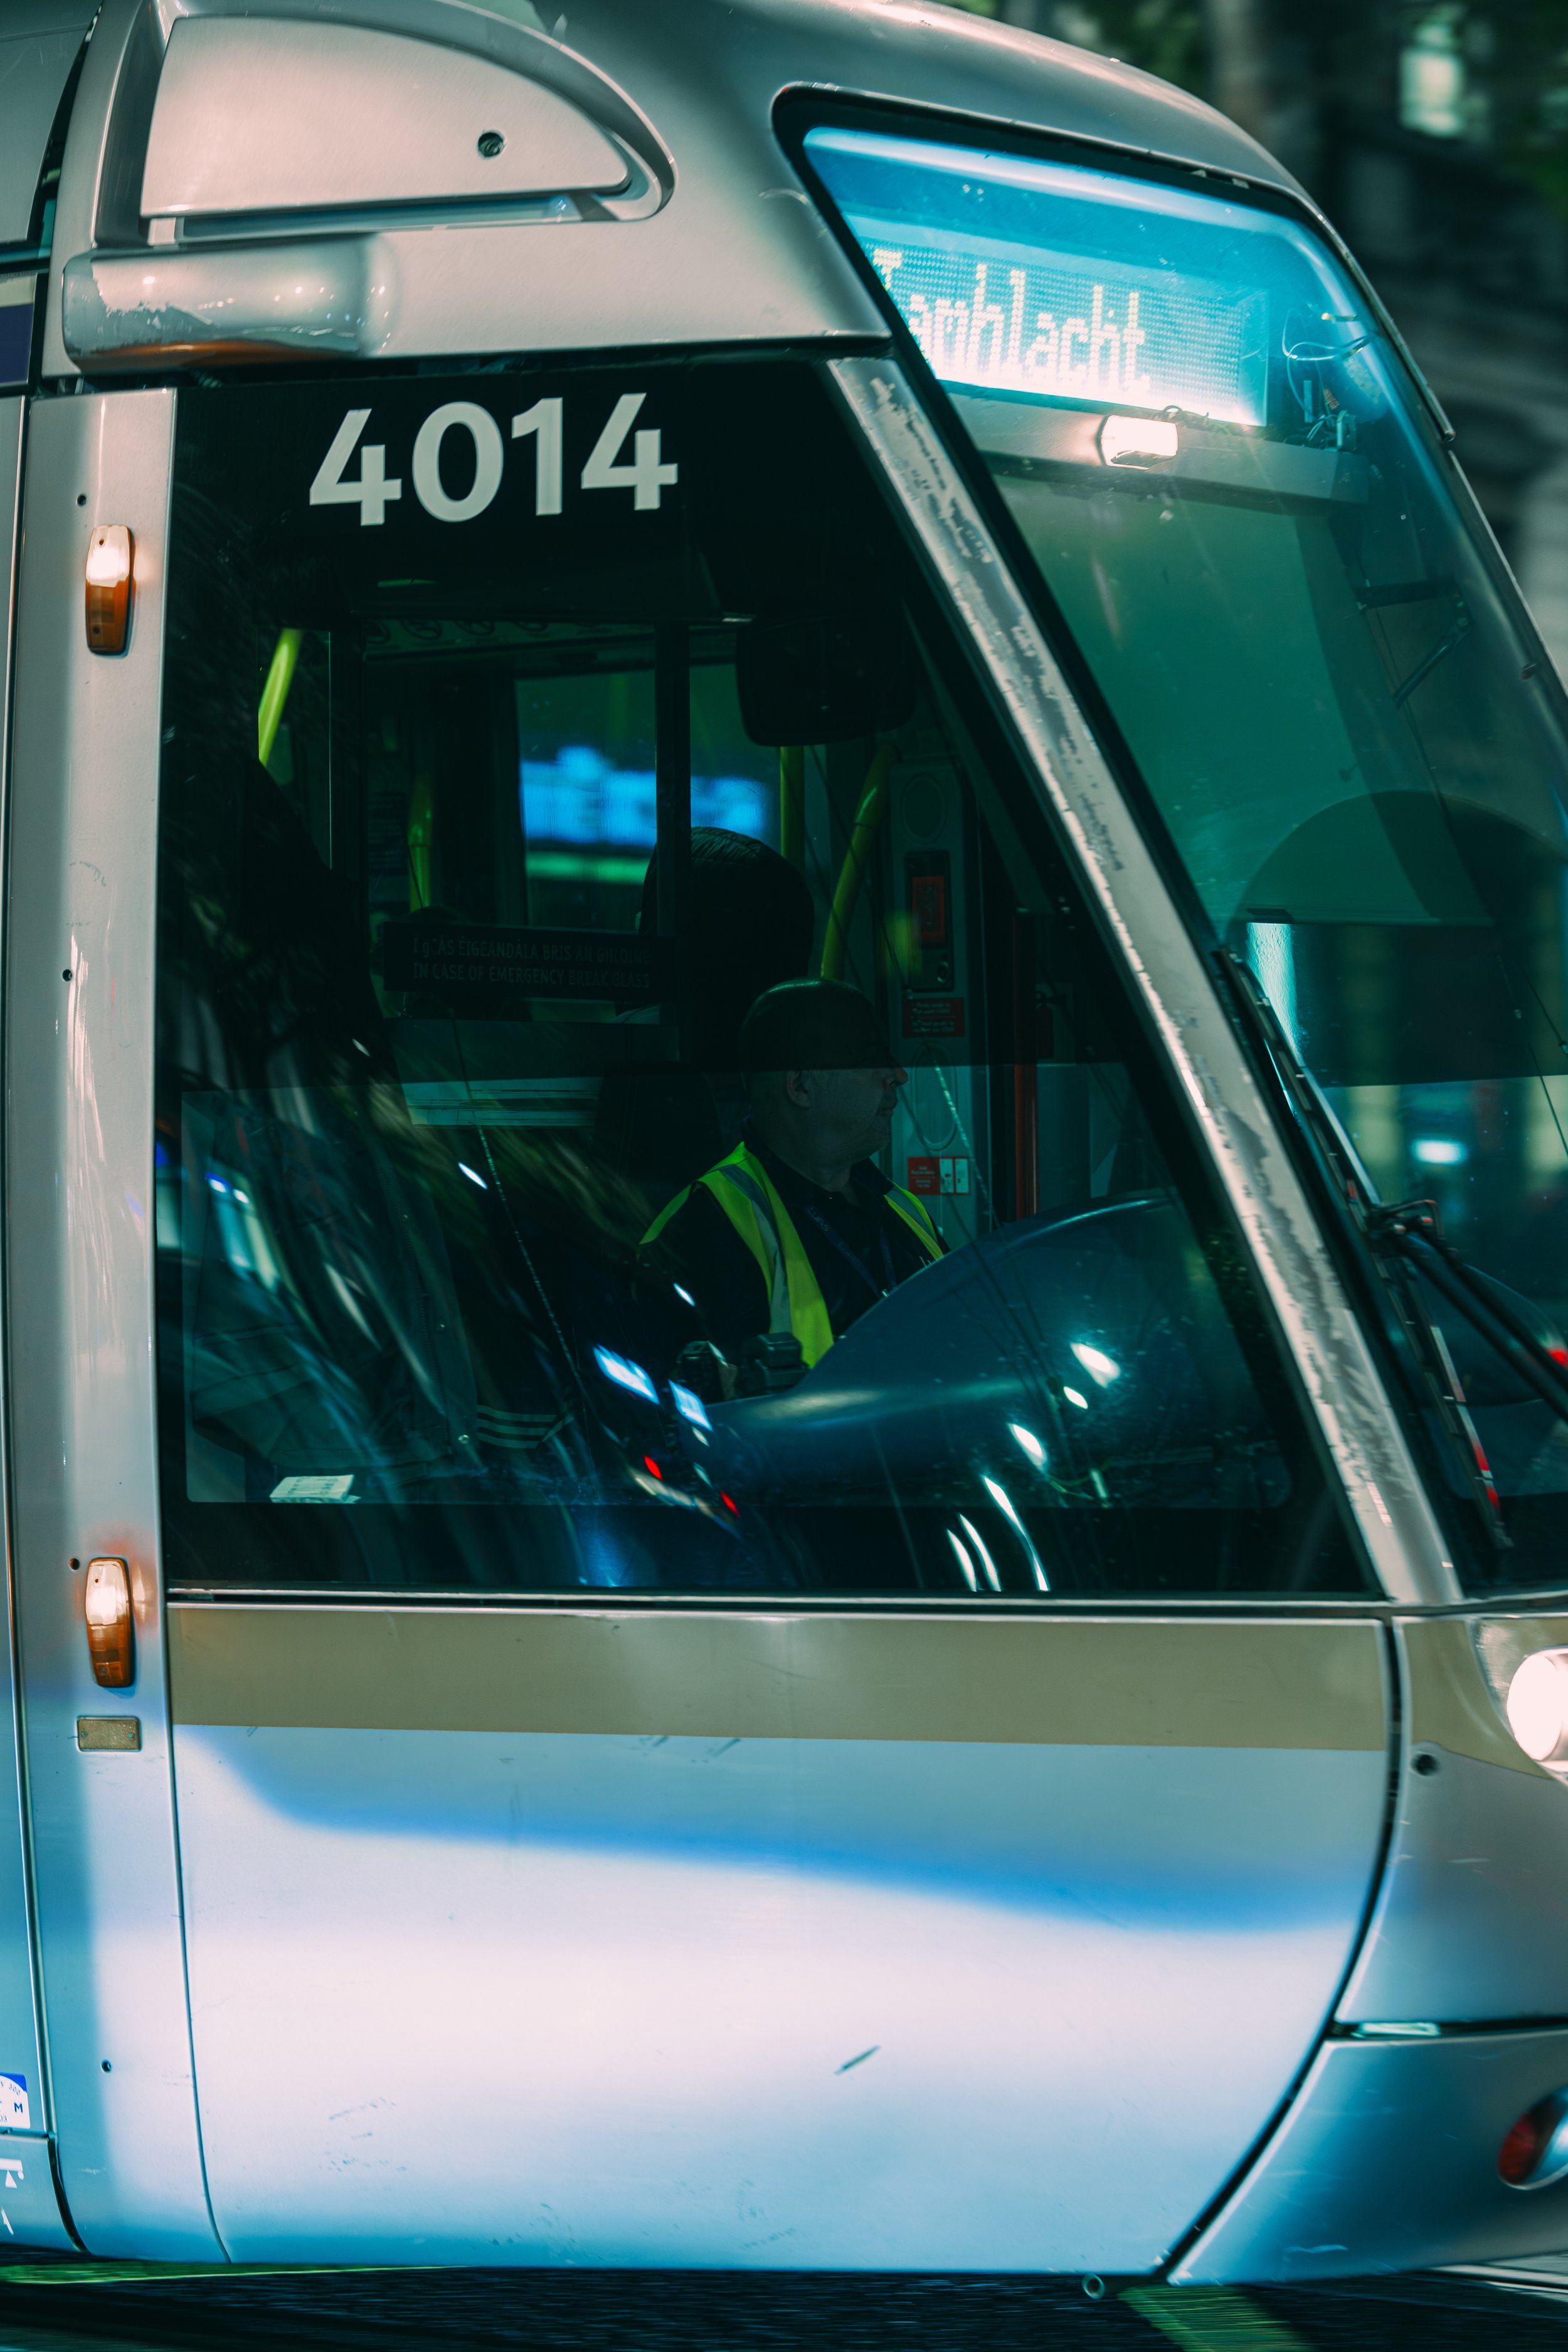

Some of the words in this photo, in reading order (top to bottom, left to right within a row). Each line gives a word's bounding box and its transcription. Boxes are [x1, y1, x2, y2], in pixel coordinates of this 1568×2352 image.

[309, 393, 678, 526] 4014
[458, 936, 539, 960] ÉIGEANDÁLA
[543, 944, 572, 961] BRIS
[575, 945, 592, 962] AN
[596, 947, 650, 964] GHLOINE
[413, 963, 428, 979] IN
[432, 963, 465, 981] CASE
[469, 965, 485, 982] OF
[489, 967, 566, 985] EMERGENCY
[568, 970, 608, 987] BREAK
[612, 972, 651, 988] GLASS
